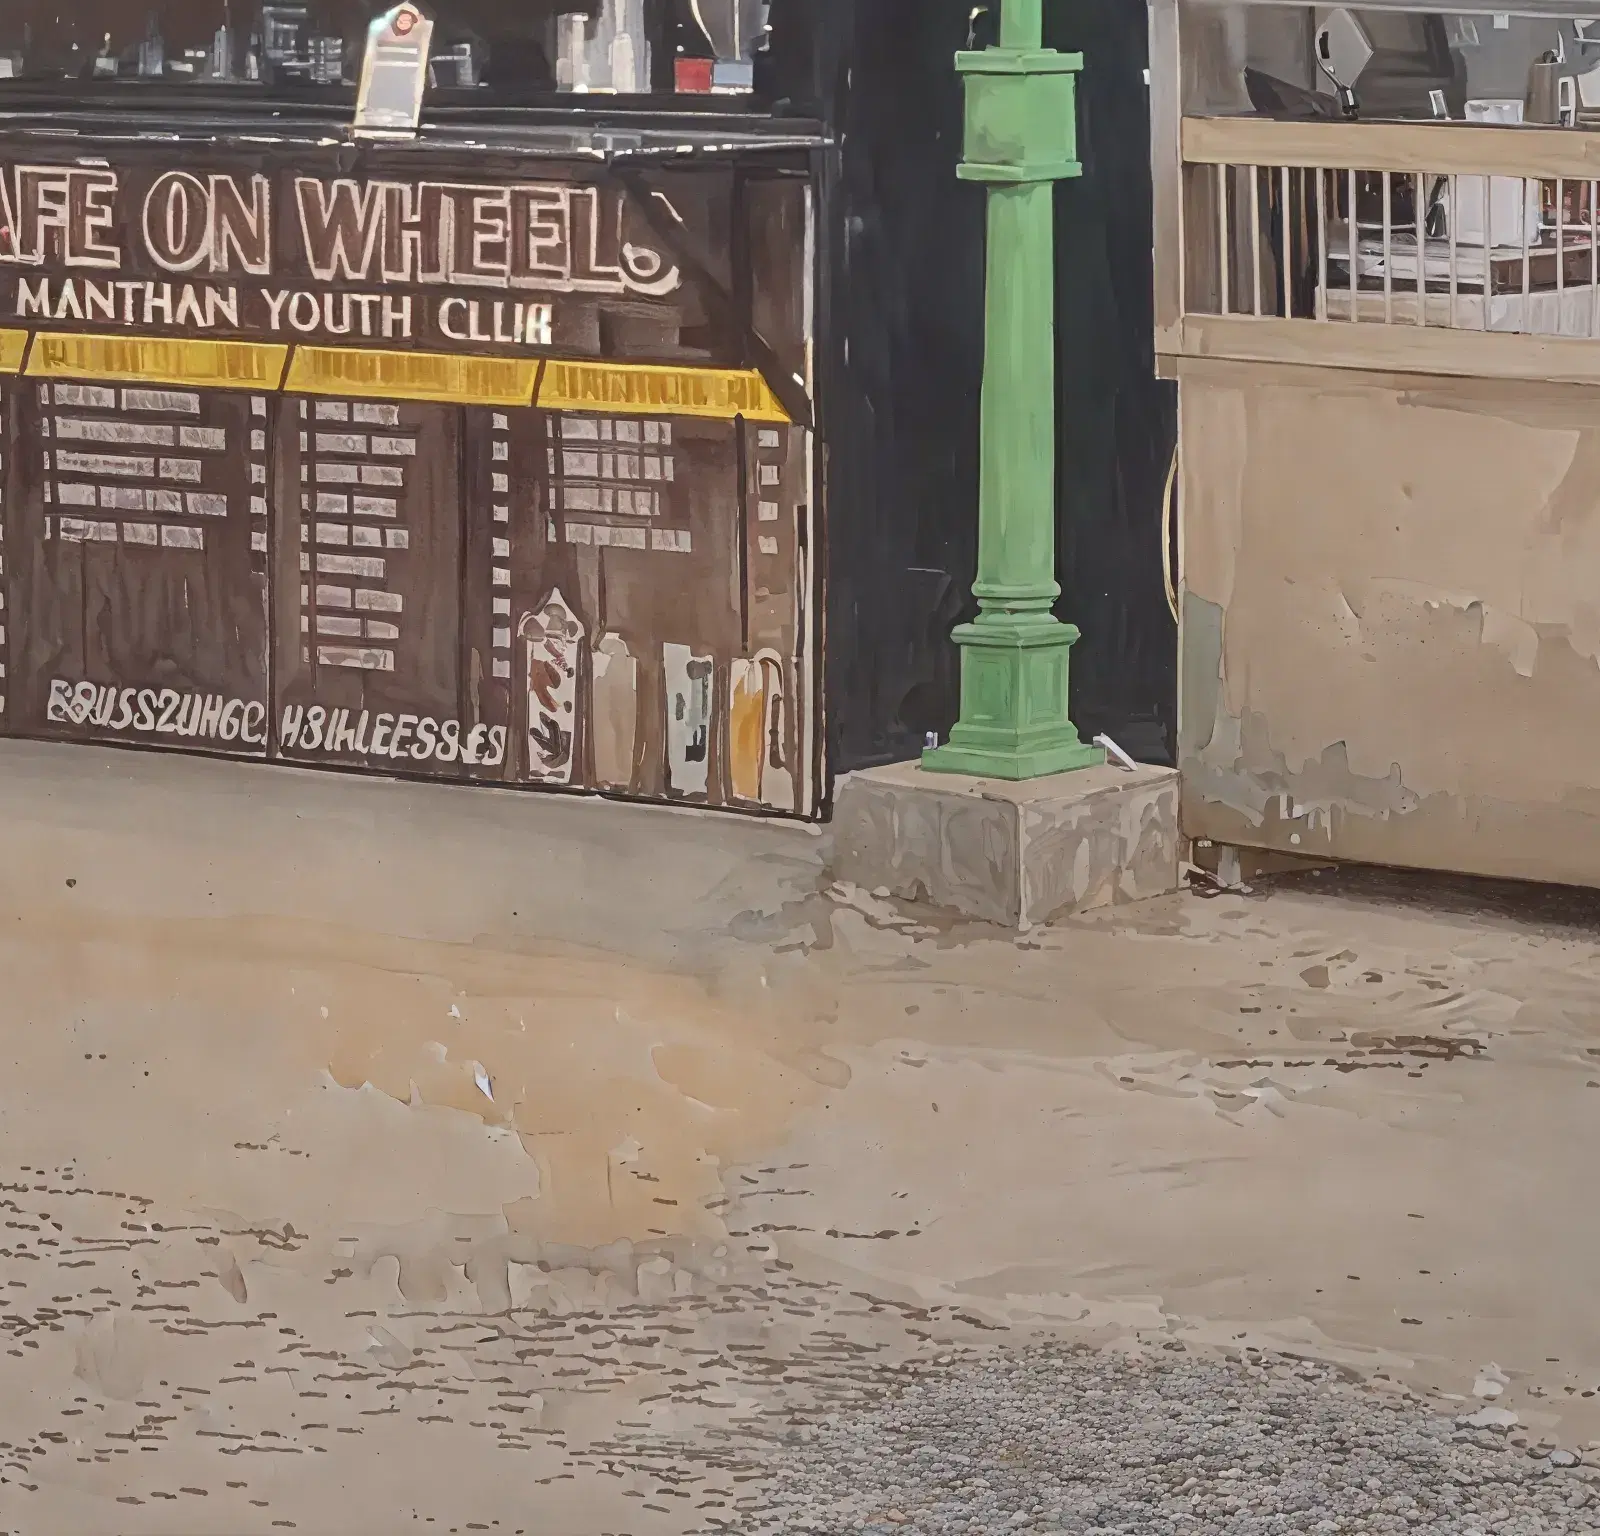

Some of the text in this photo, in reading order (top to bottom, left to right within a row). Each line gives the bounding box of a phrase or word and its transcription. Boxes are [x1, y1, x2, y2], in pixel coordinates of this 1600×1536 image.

[142, 170, 271, 275] ON
[15, 277, 240, 328] MANTHAN
[260, 287, 412, 337] YOUTH
